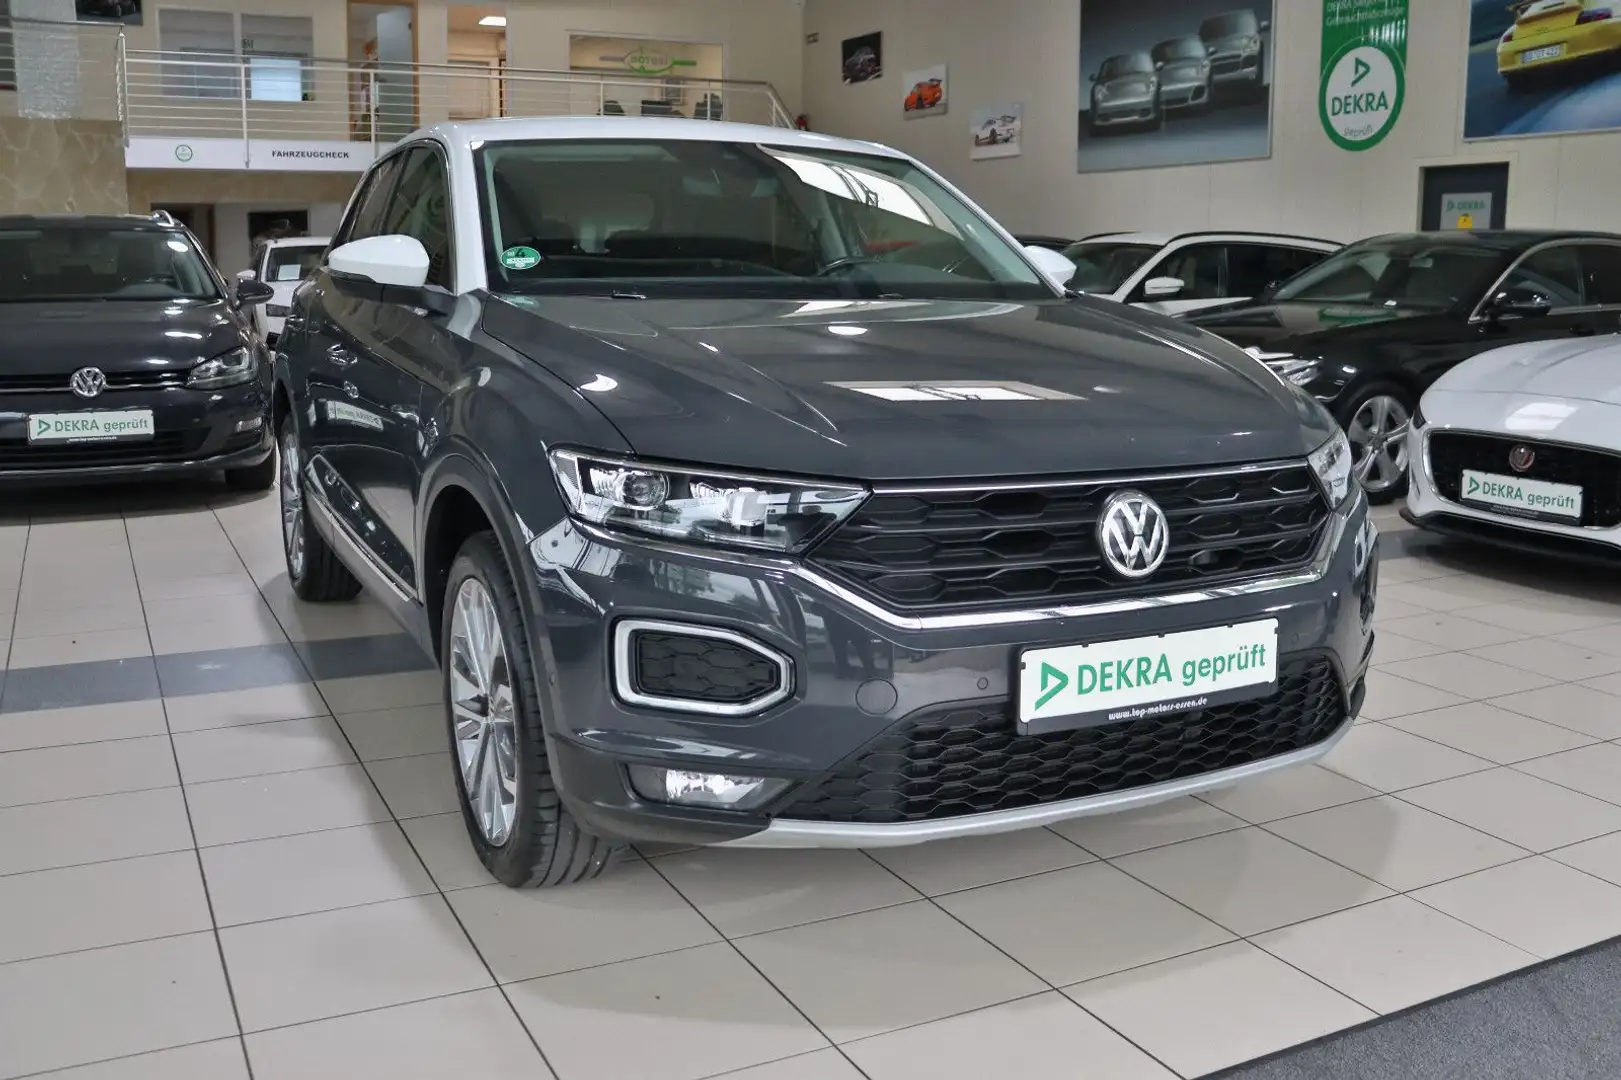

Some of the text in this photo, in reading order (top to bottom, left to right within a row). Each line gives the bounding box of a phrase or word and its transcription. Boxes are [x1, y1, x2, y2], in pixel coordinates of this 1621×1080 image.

[1331, 91, 1388, 116] DEKRA
[271, 150, 350, 159] FAHRZEUGCHECK
[55, 418, 148, 432] DEKRA geprüft
[1482, 481, 1574, 509] DEKRA geprüft
[1077, 644, 1265, 696] DEKRA geprüft
[1108, 697, 1208, 721] www.top-motors-essen.de
